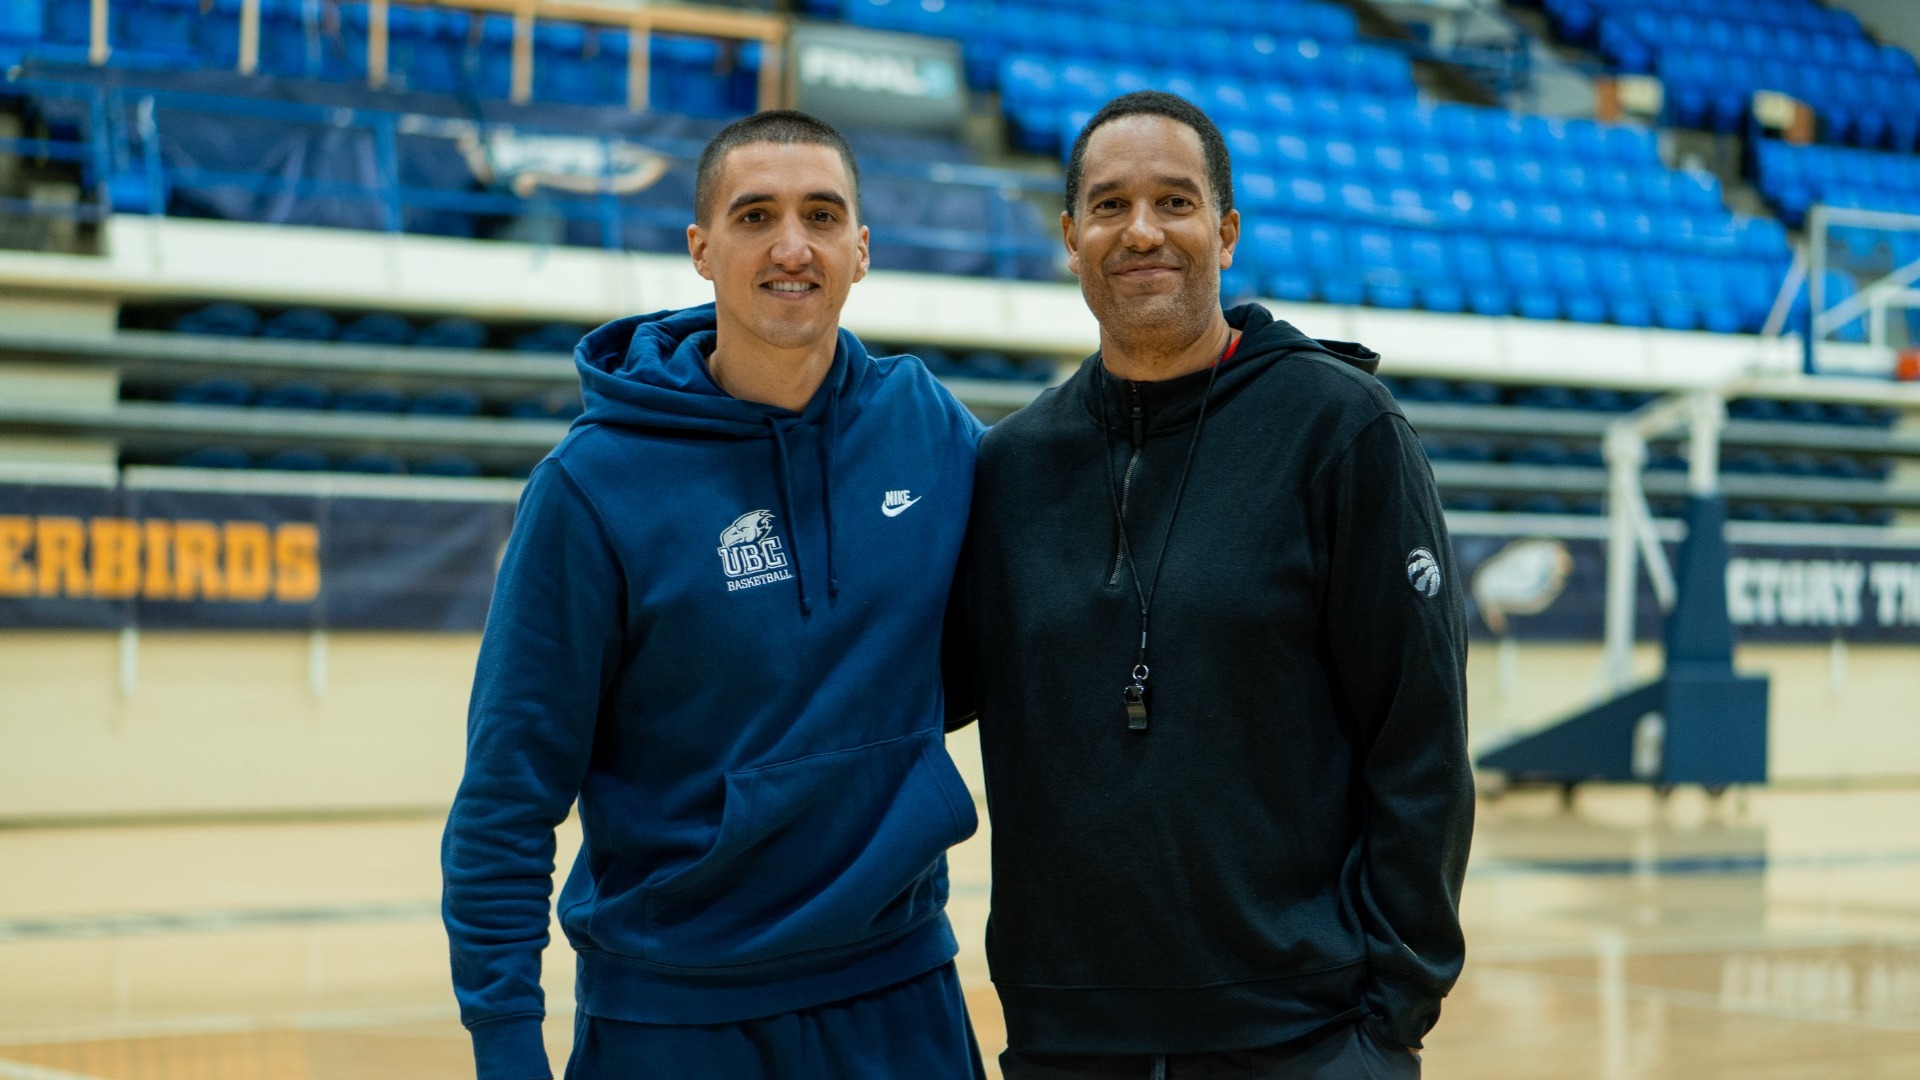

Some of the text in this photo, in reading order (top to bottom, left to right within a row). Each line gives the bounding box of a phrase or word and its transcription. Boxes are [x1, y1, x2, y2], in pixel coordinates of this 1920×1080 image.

[885, 490, 911, 506] NIKE
[0, 514, 321, 603] ERBIRDS
[717, 536, 788, 577] UBC
[726, 569, 792, 591] BASKETBALL
